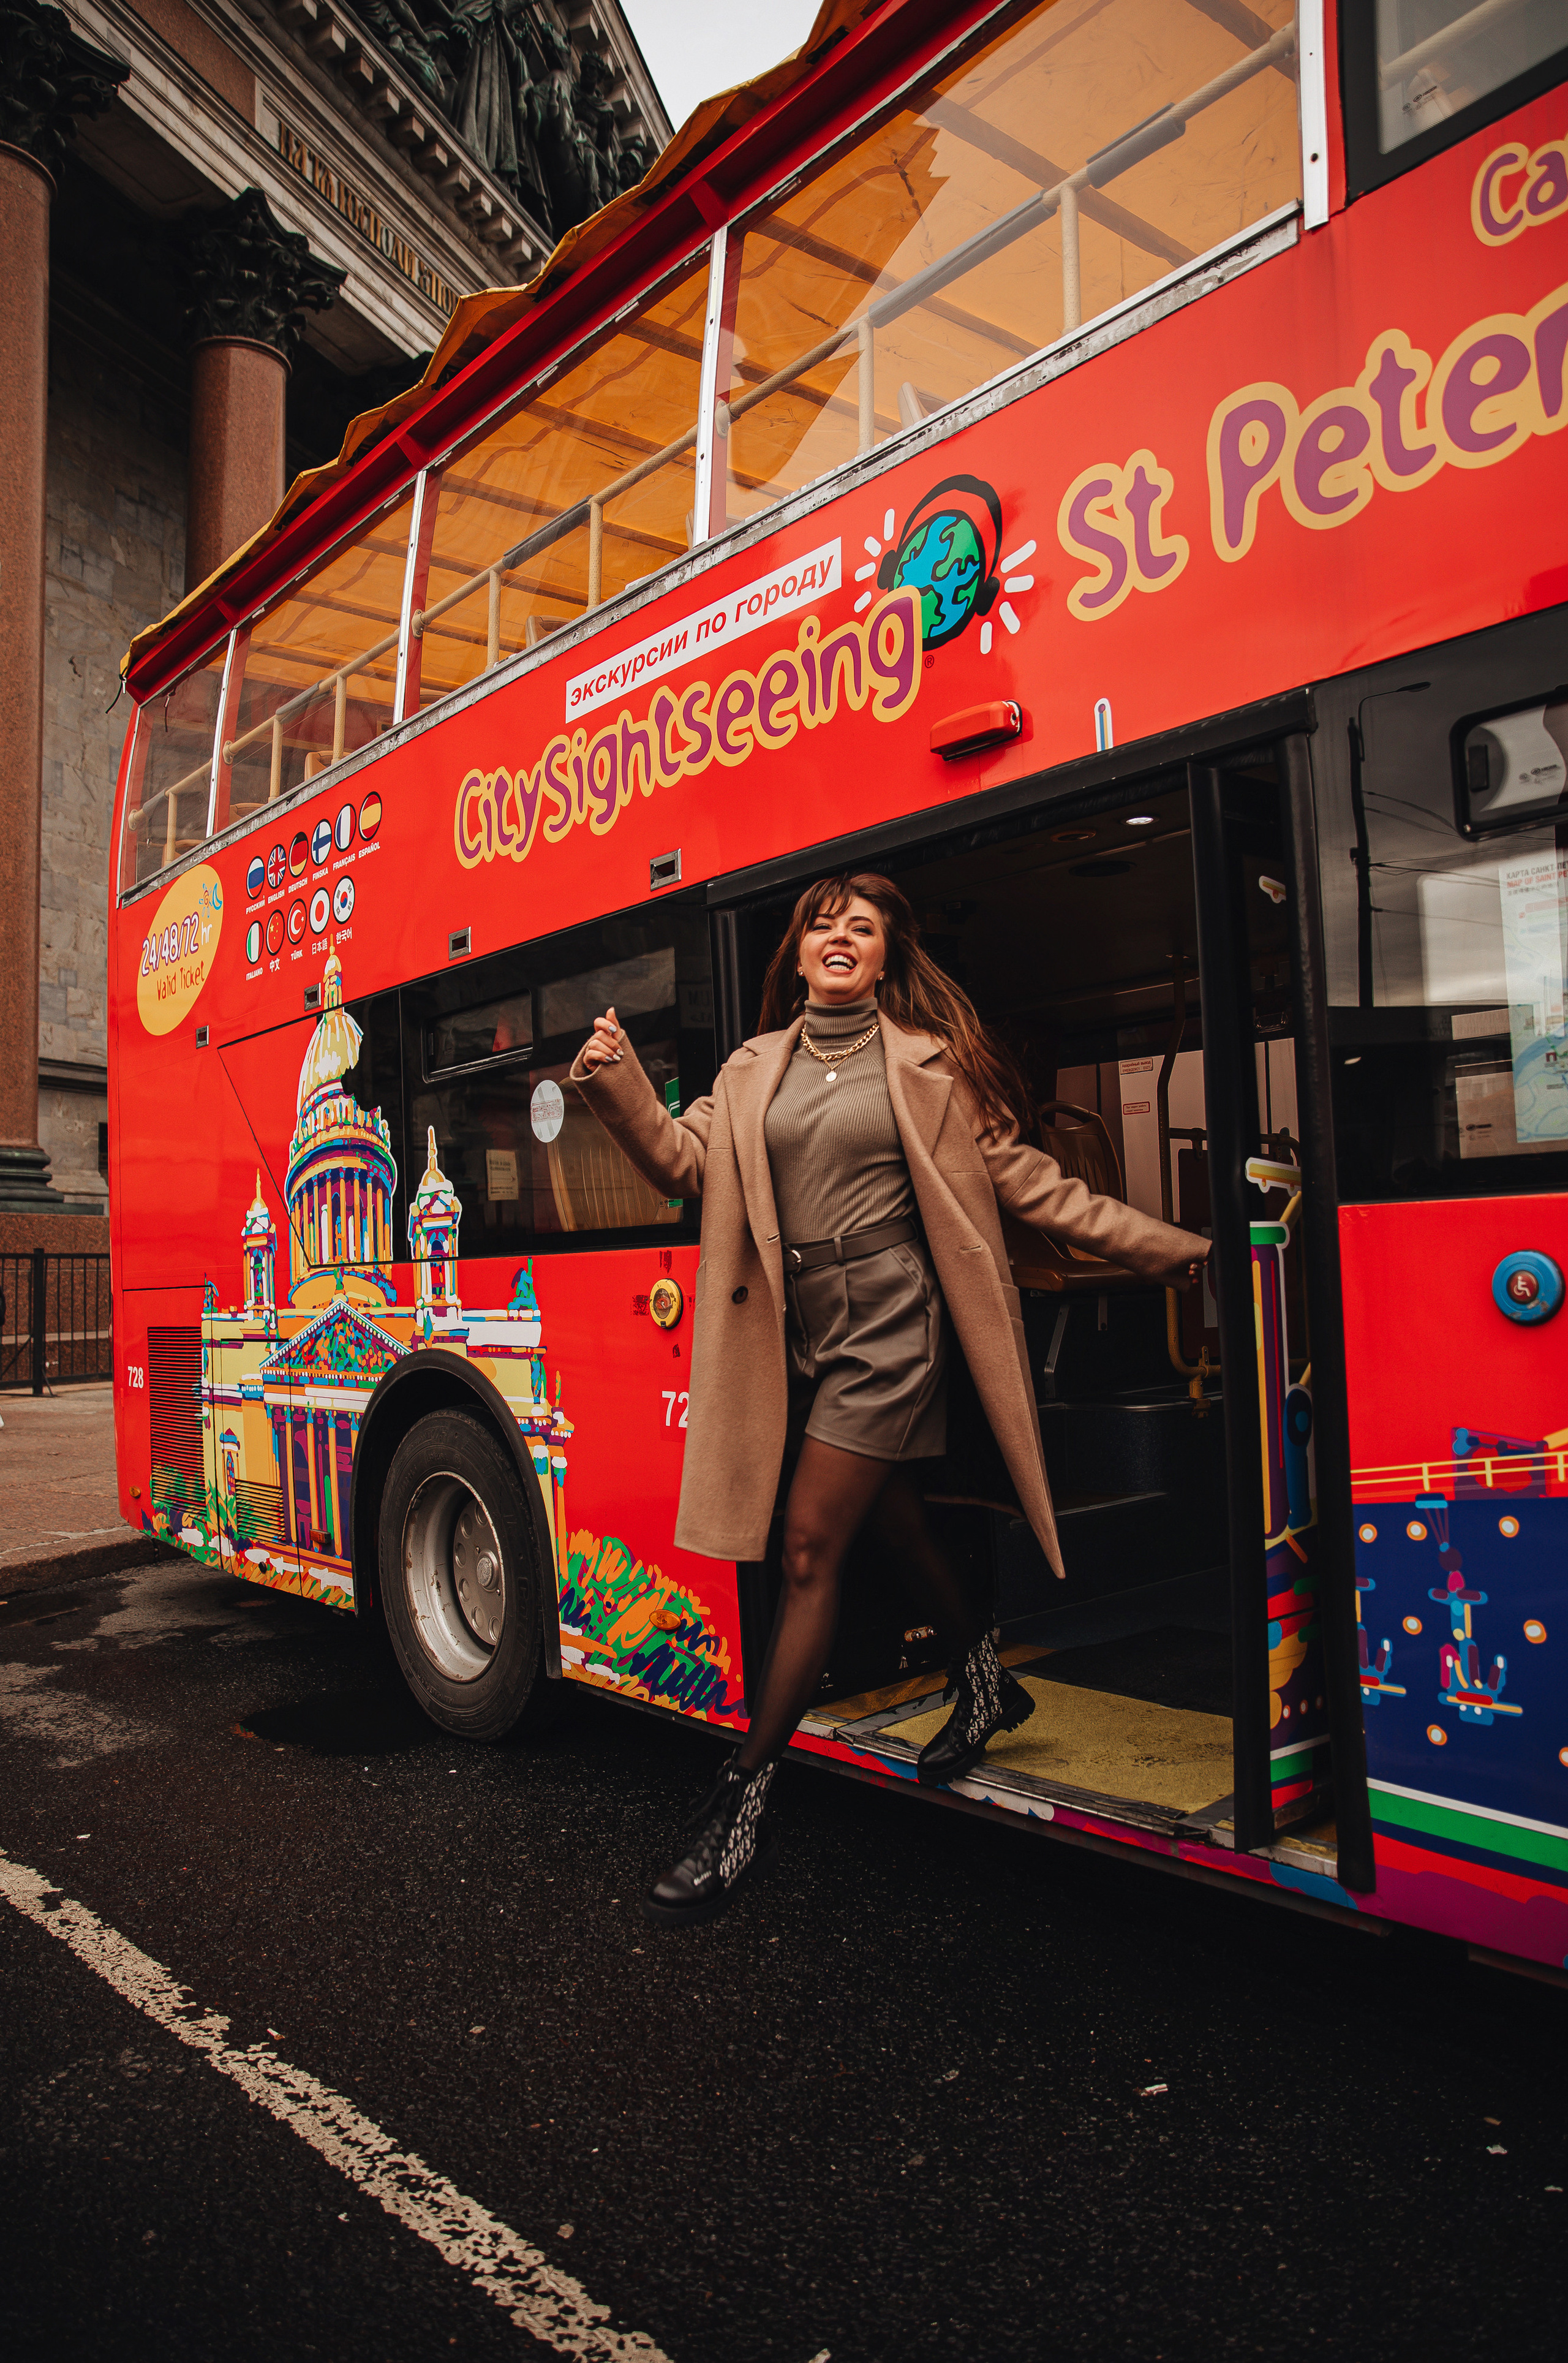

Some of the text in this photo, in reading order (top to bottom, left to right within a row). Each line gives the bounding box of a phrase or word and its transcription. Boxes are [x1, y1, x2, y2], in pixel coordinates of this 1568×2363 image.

[1059, 452, 1187, 618] St
[570, 554, 834, 707] экскурсии по городу
[358, 841, 381, 859] ESPAÑOL
[333, 853, 356, 871] FRANÇAIS
[312, 866, 329, 882] FINSKA
[1506, 870, 1529, 880] КАРТА
[1507, 879, 1523, 888] MAP
[1524, 876, 1533, 885] OF
[1535, 872, 1556, 883] SAINT
[288, 877, 308, 894] DEUTSCH
[246, 894, 265, 915] РУССКИЙ
[268, 889, 285, 904] ENGLISH
[141, 912, 213, 977] 24/48/72 hr
[336, 926, 353, 945] 한국어
[290, 950, 303, 961] TÜRK
[312, 937, 328, 956] 日本語
[246, 967, 263, 981] ITALIANO
[270, 958, 280, 973] 中文
[156, 960, 205, 1002] Valid Ticket
[127, 1366, 144, 1389] 728
